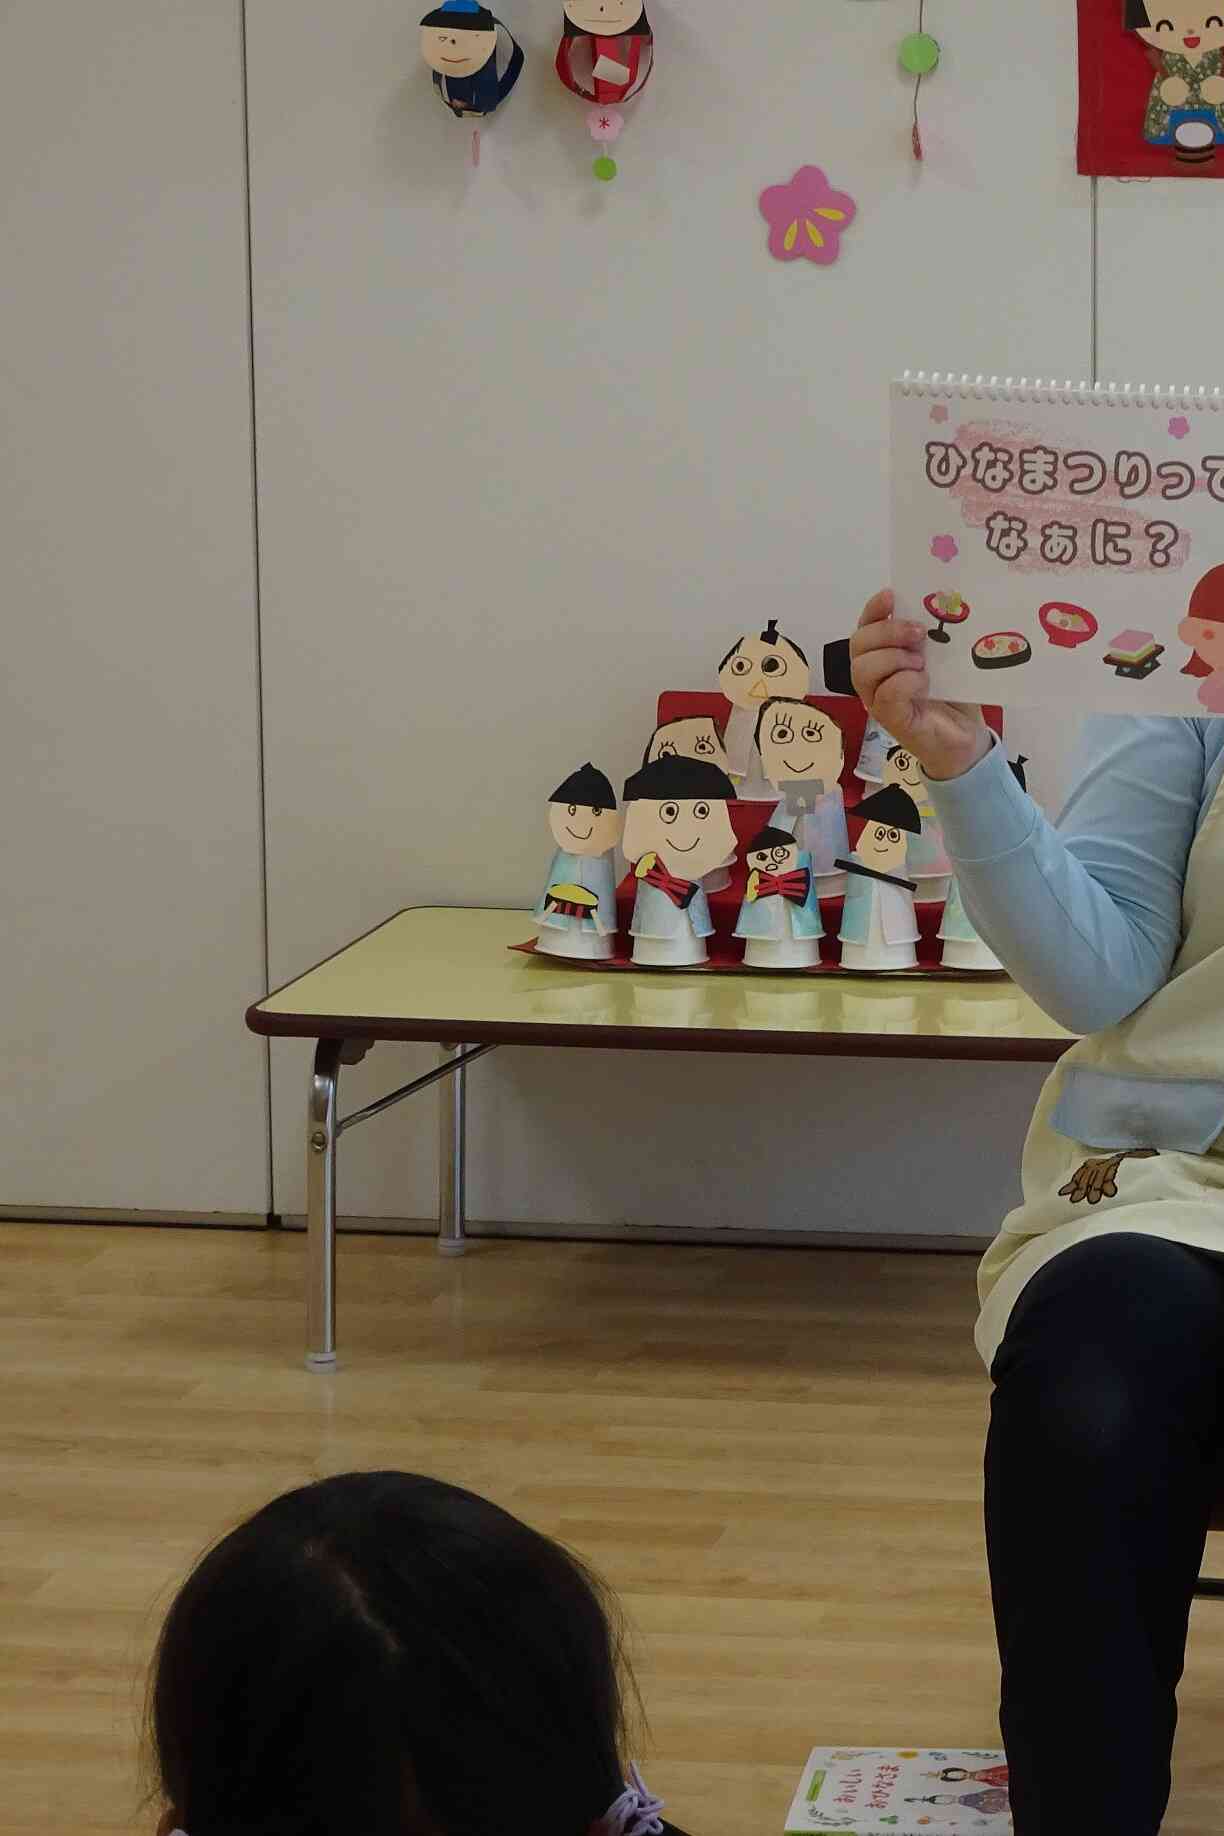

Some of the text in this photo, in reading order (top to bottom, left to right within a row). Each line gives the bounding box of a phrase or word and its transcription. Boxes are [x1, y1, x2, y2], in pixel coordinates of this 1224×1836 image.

[834, 1769, 863, 1804] おいしい
[865, 1764, 900, 1809] おひなさま
